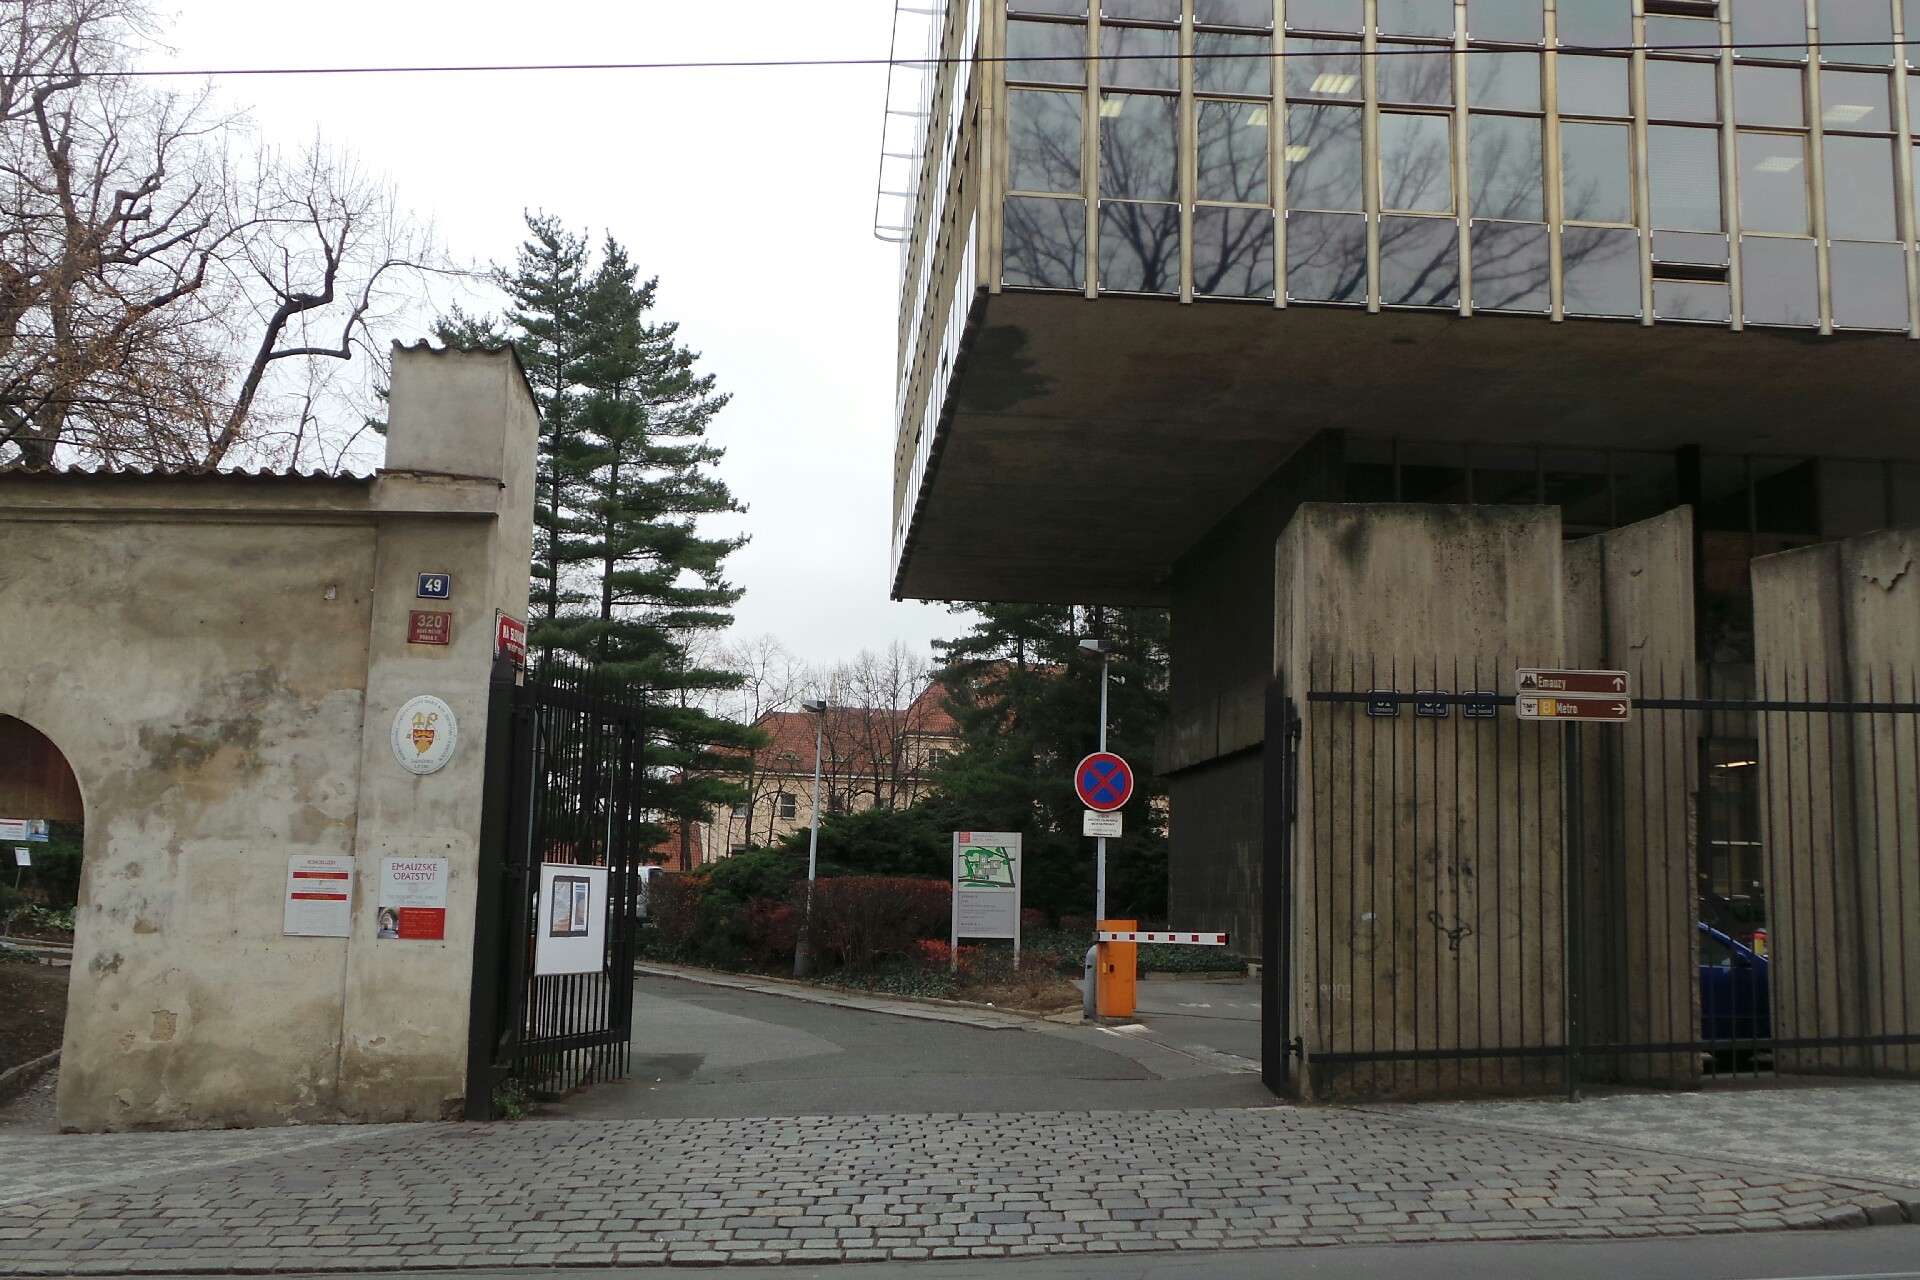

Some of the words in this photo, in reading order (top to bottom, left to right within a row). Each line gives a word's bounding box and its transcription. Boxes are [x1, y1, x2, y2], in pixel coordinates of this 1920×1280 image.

[425, 580, 442, 592] 49
[418, 615, 442, 628] 320
[1538, 676, 1566, 690] Emauzy
[1543, 701, 1551, 713] B
[1556, 702, 1578, 714] Metro
[391, 862, 438, 872] EMAUZSKÉ
[393, 872, 435, 881] OPATSTVÍ
